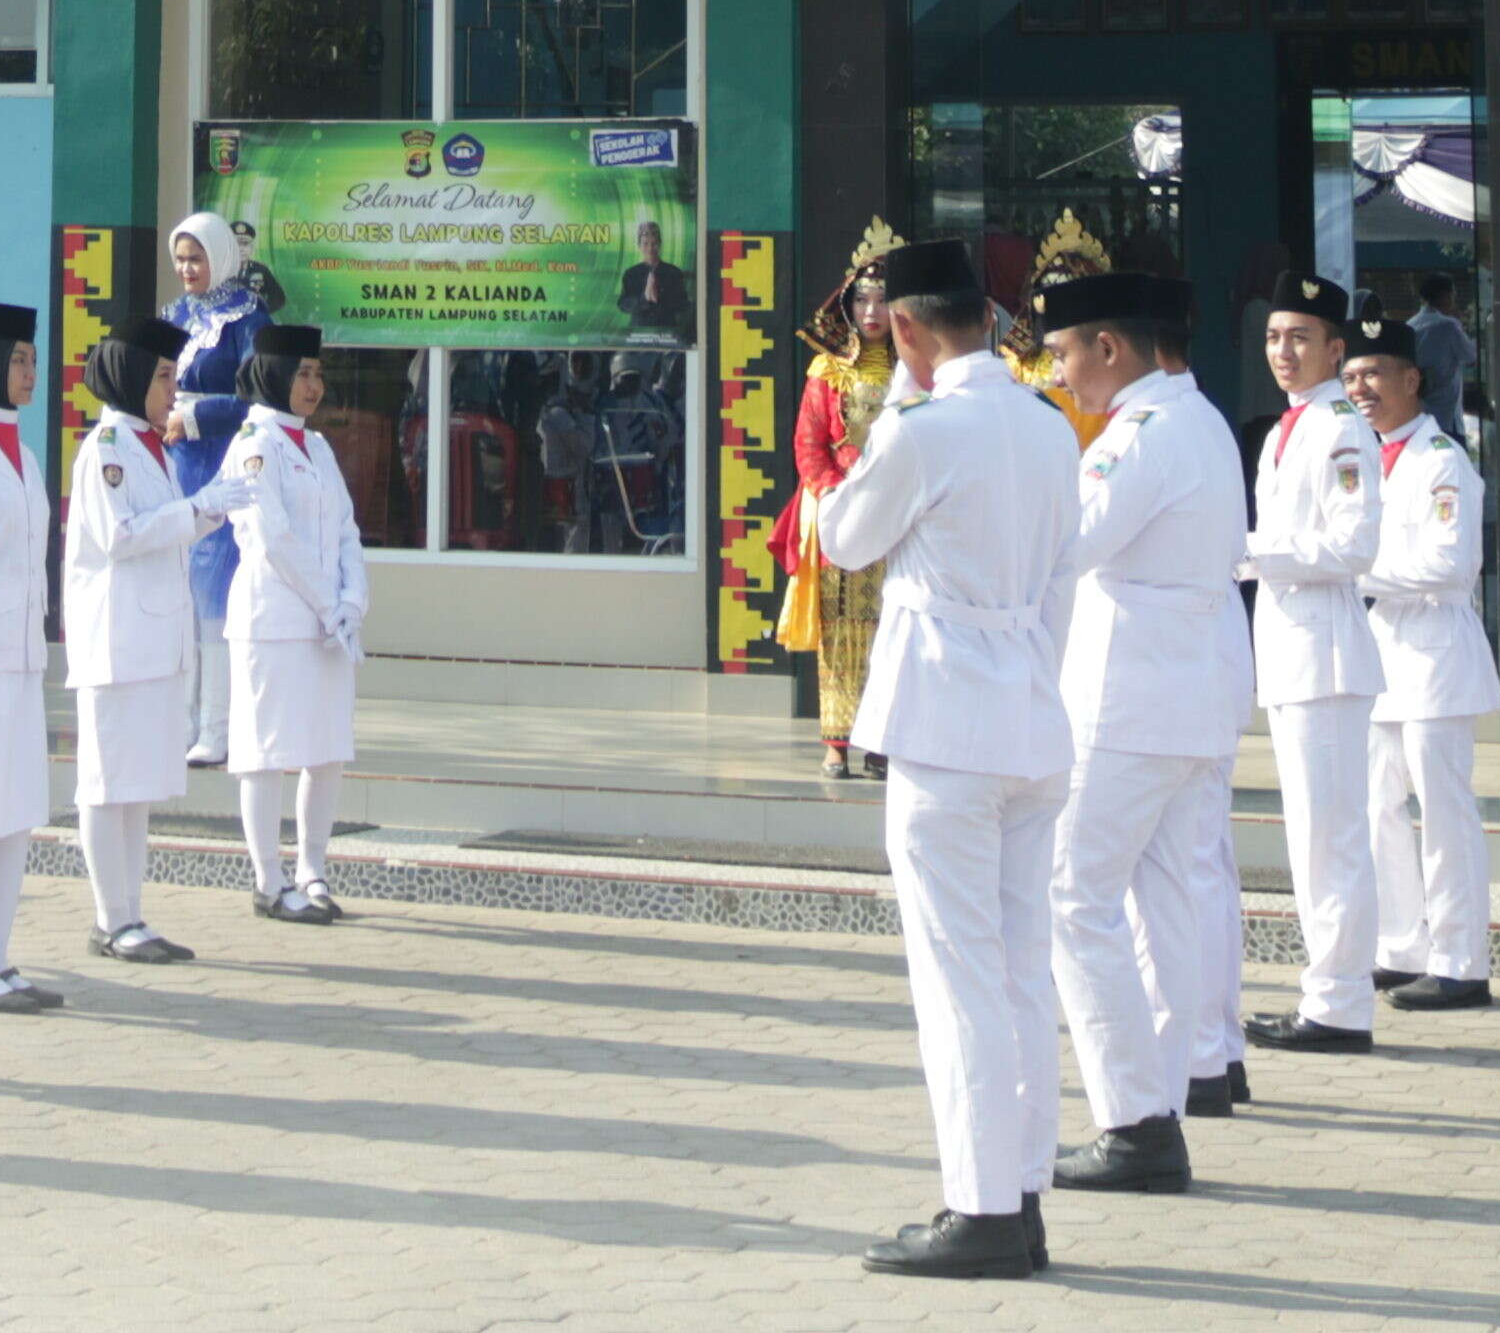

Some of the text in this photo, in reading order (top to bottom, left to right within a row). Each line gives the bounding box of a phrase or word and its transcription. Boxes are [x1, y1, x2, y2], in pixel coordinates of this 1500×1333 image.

[599, 134, 644, 153] SEKOLAH
[343, 183, 535, 220] Selamat Datang
[283, 221, 611, 245] KAPOLRES LAMPUNG SELATAN
[361, 284, 546, 302] SMAN 2 KALIANDA
[340, 306, 568, 322] KABUPATEN LAMPUNG SELATAN
